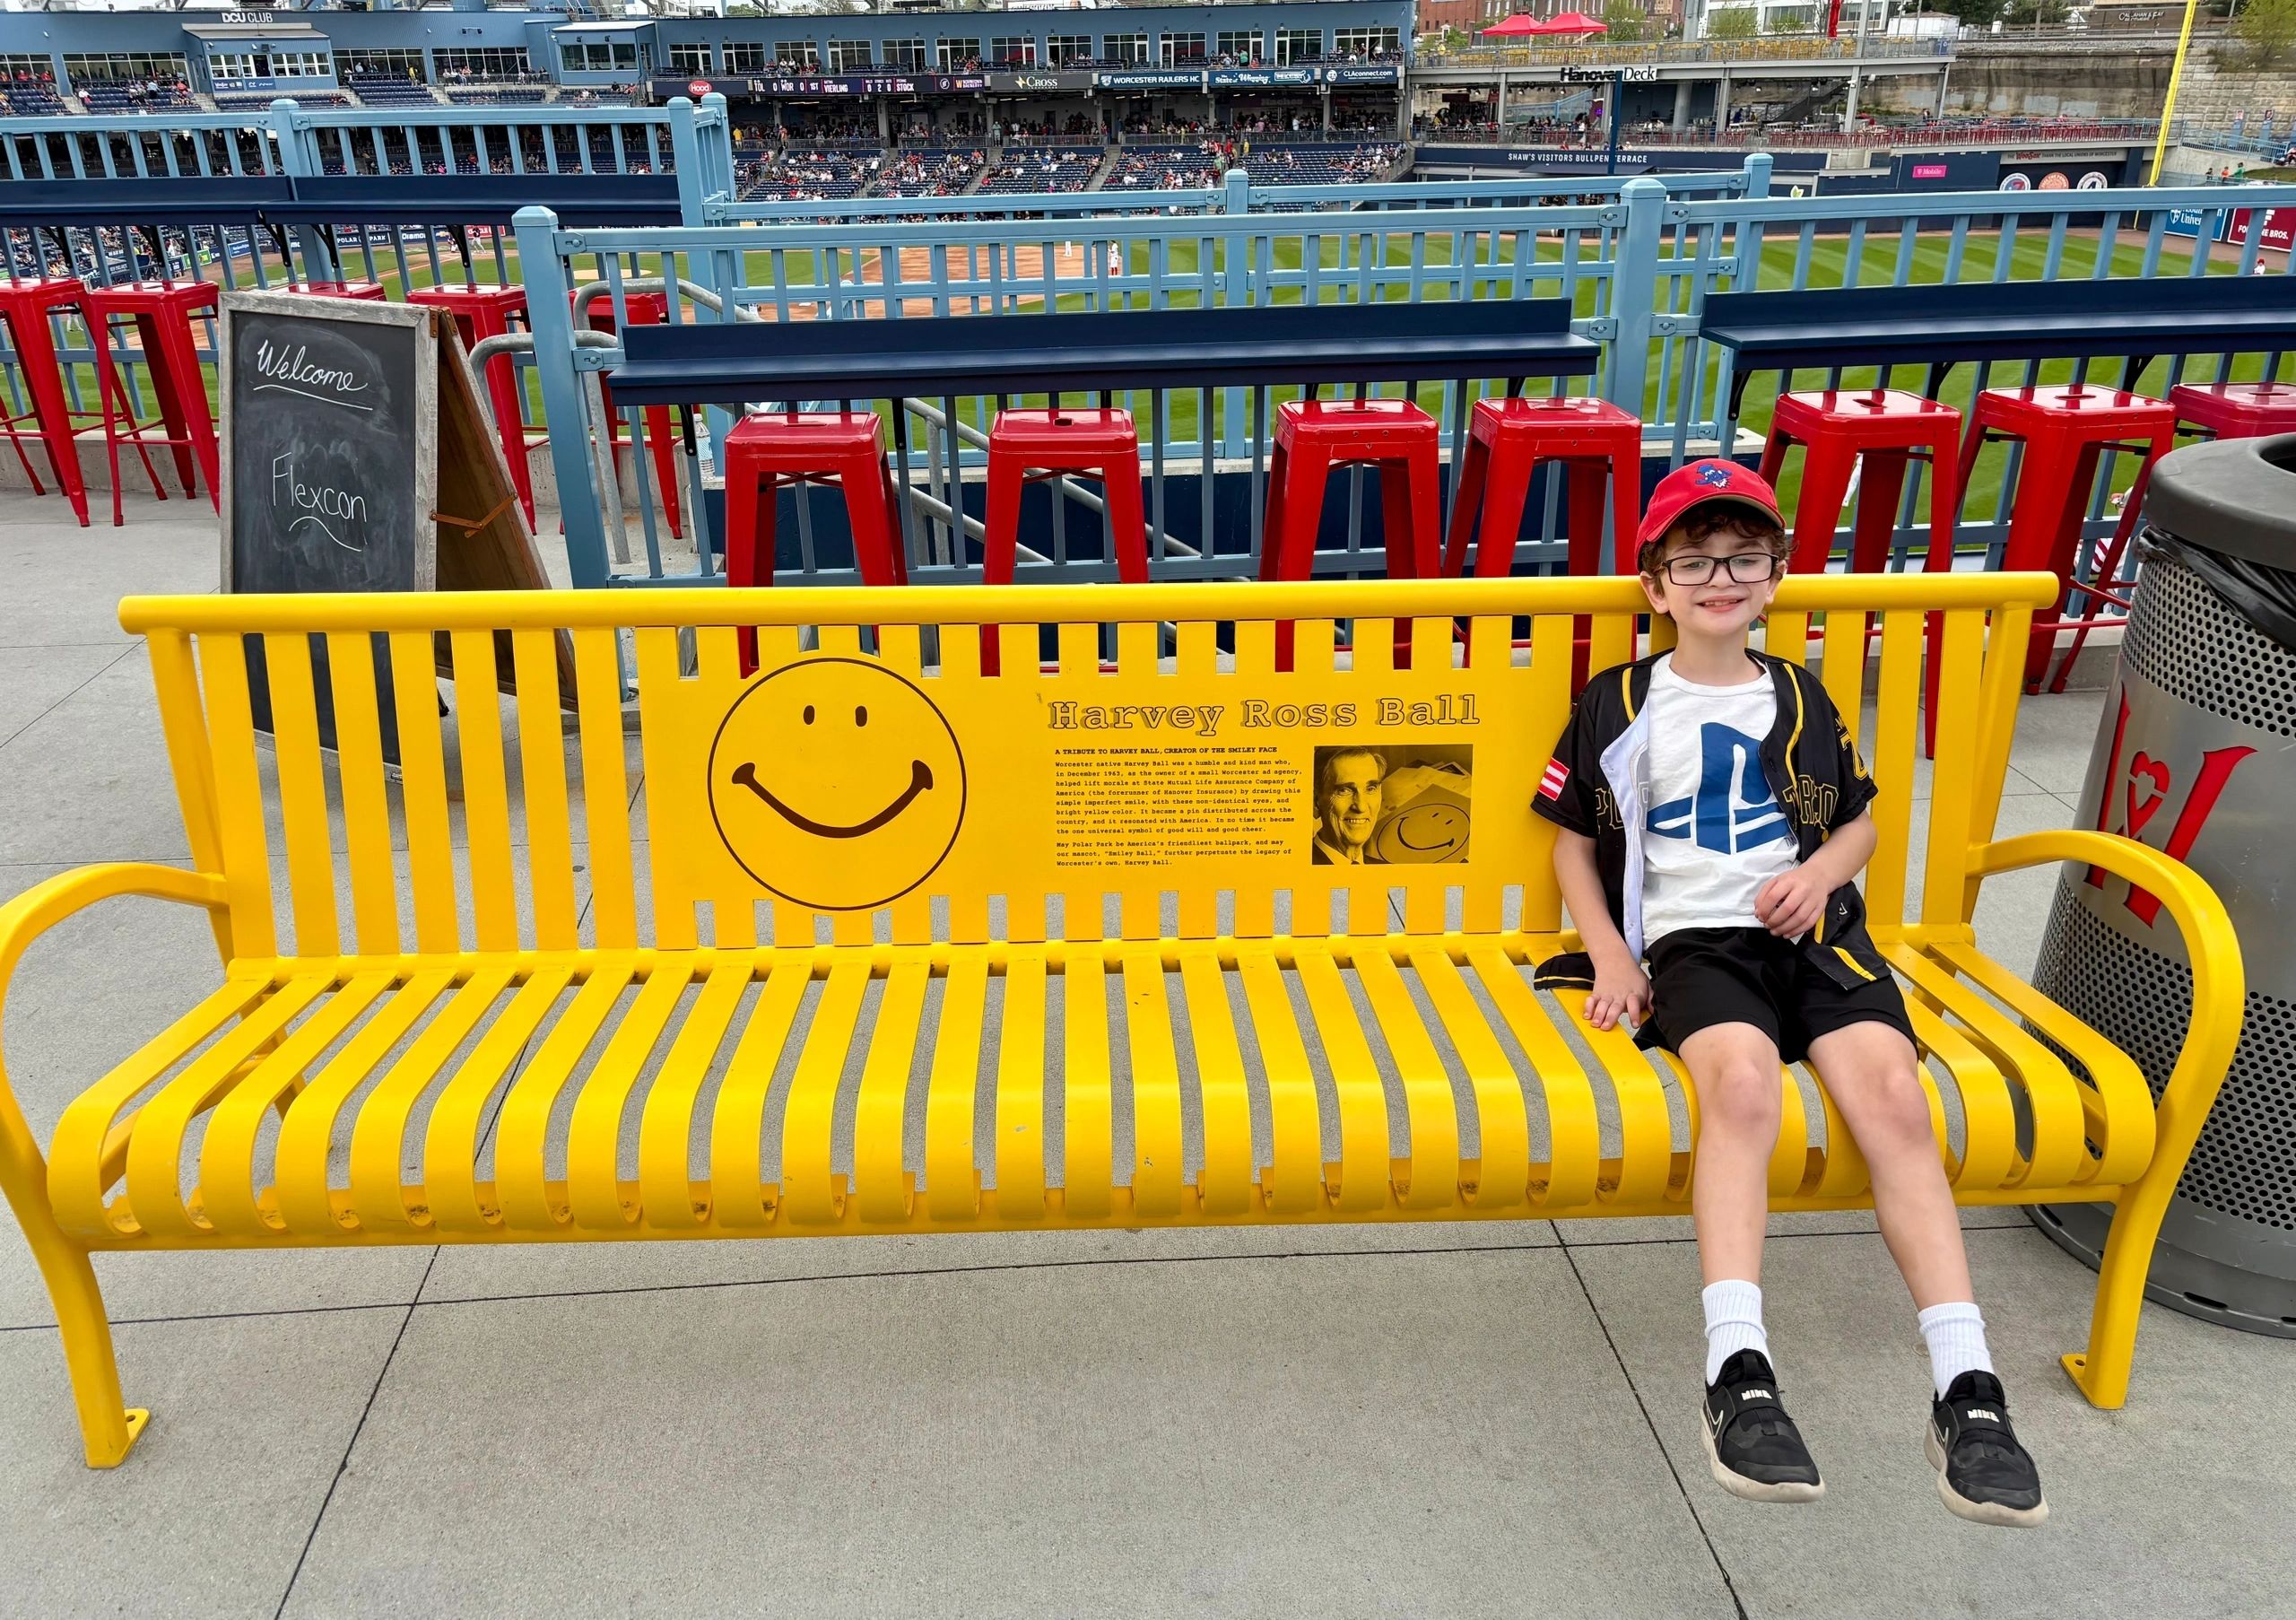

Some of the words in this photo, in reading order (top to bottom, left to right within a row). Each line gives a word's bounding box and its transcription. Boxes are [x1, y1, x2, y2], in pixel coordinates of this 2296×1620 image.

[222, 13, 246, 23] DCU
[248, 12, 273, 23] CLUB
[1561, 67, 1617, 82] Hanove
[1623, 65, 1655, 81] Deck
[1113, 76, 1157, 84] WORCESTER
[1158, 75, 1188, 83] RAILERS
[691, 83, 709, 91] Hood
[780, 82, 794, 91] WOR
[810, 83, 819, 91] 1ST
[897, 83, 914, 91] STOCK
[1508, 153, 1535, 161] SHAW'S
[1537, 153, 1573, 162] VISITORS
[1575, 154, 1609, 162] BULLPEN
[2180, 213, 2202, 226] Univer
[2269, 230, 2289, 240] BROS.
[257, 339, 369, 392] Welcome
[273, 451, 368, 523] Flexcon
[1049, 701, 1224, 737] Harvey
[1239, 699, 1357, 727] Ross
[1375, 694, 1481, 726] Ball
[1062, 748, 1096, 756] TRIBUTE
[1097, 747, 1109, 755] TO
[1109, 747, 1139, 755] HARVEY
[1163, 746, 1197, 754] CREATOR
[1198, 746, 1210, 754] OF
[1227, 746, 1257, 754] SMILEY
[1257, 745, 1278, 753] FACE
[1066, 770, 1100, 778] December
[1055, 780, 1082, 788] helped
[1084, 780, 1100, 788] lift
[1255, 778, 1285, 786] Company
[1088, 788, 1105, 797] (the
[1196, 788, 1238, 796] Insurance)
[1056, 799, 1082, 807] simple
[1084, 798, 1122, 806] imperfect
[1056, 809, 1082, 817] bright
[1083, 808, 1109, 816] yellow
[1187, 807, 1200, 815] pin
[1159, 816, 1178, 824] with
[1127, 827, 1152, 835] symbol
[1167, 826, 1185, 835] good
[1222, 826, 1239, 834] good
[1056, 841, 1070, 849] May
[1256, 848, 1281, 856] legacy
[1124, 859, 1150, 867] Harvey
[1741, 1389, 1773, 1401] NIKE
[1967, 1408, 2000, 1423] NIKE
